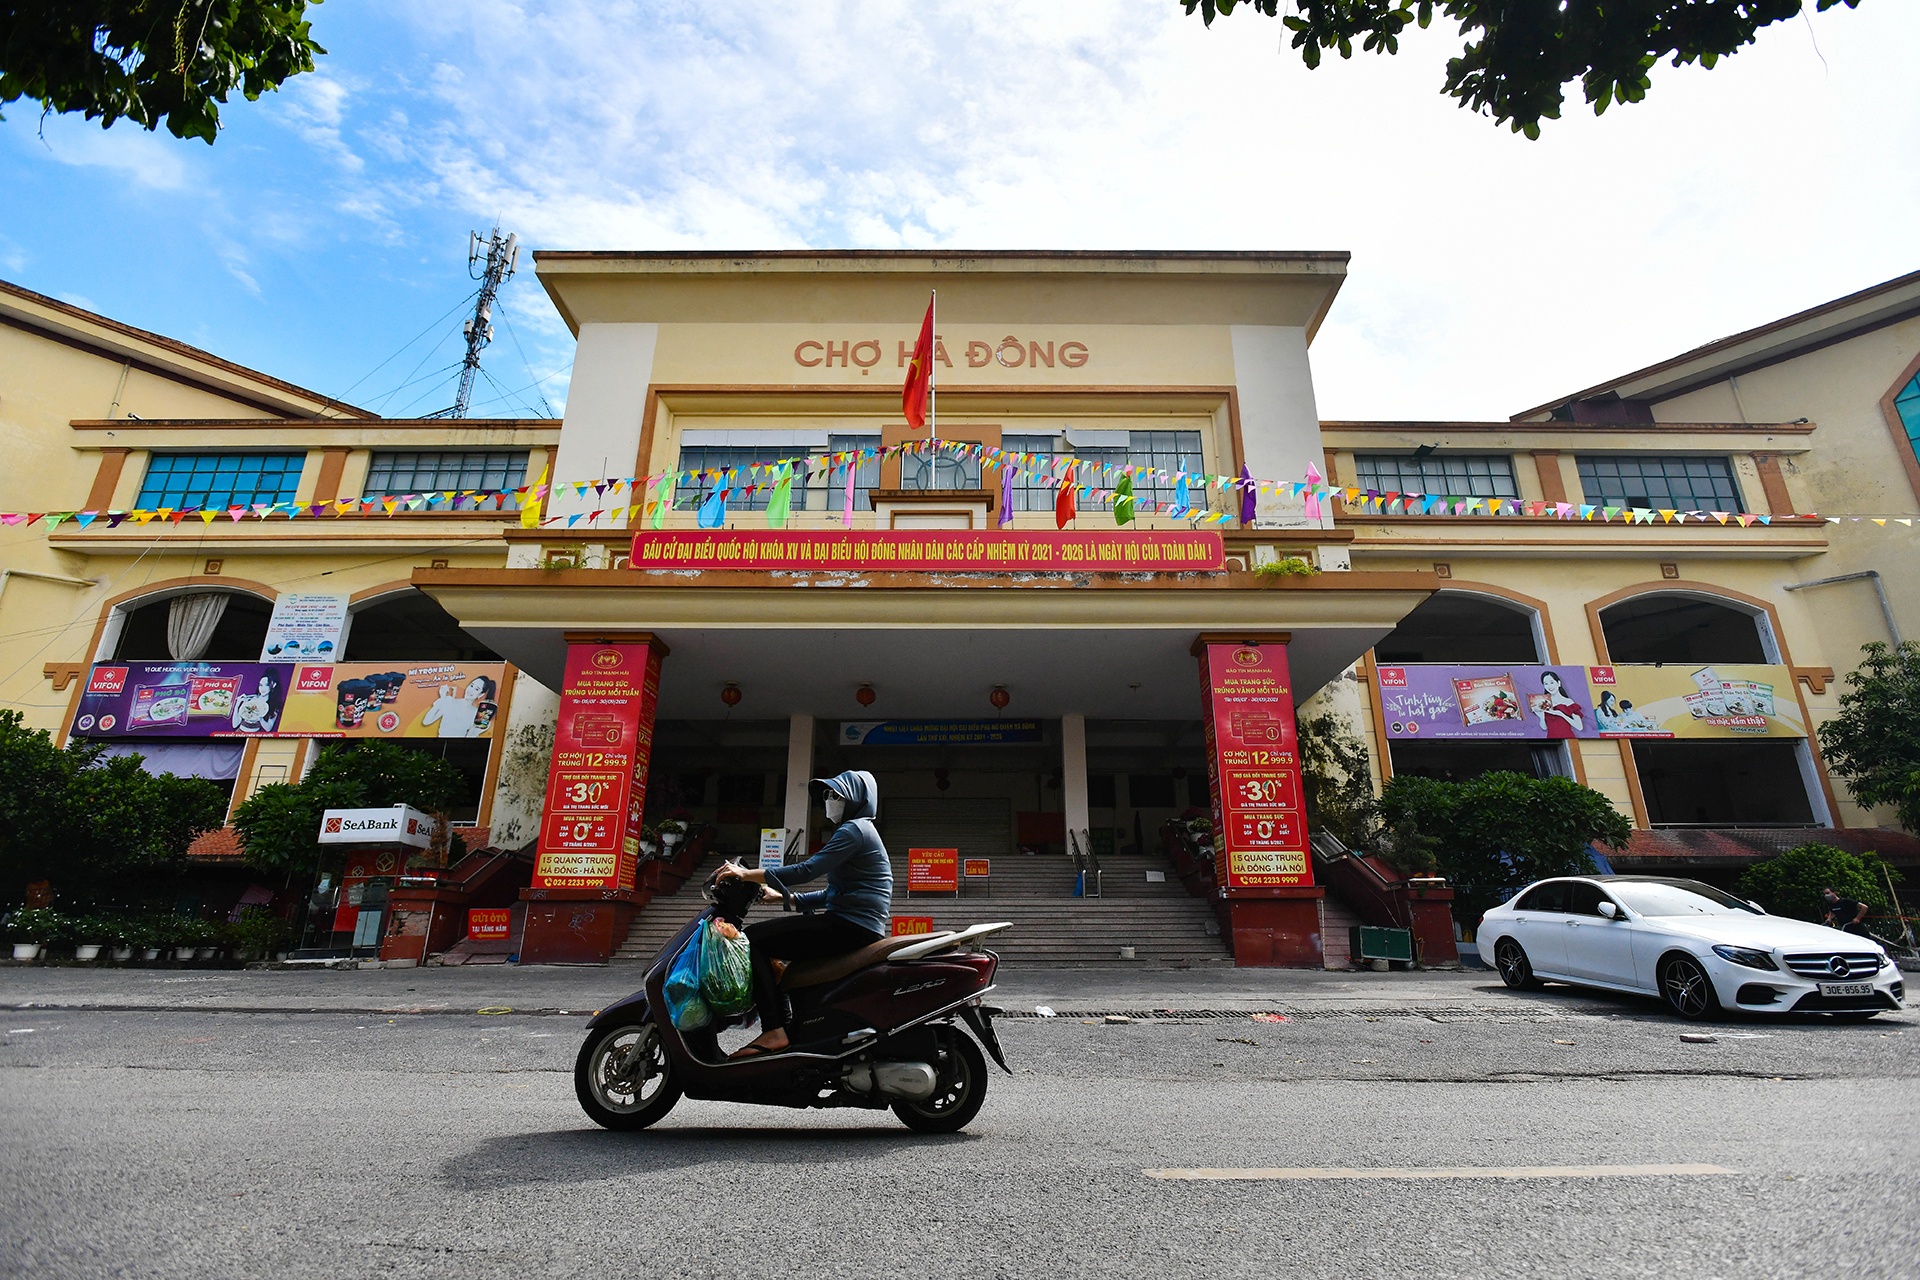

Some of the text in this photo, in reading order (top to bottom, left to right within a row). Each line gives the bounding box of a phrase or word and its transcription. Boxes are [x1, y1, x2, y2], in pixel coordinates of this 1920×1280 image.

[794, 340, 882, 376] CHỢ
[965, 335, 1089, 368] ĐÔNG
[643, 537, 661, 559] BẦU
[663, 536, 678, 559] CỬ
[677, 543, 694, 563] ĐẠI
[694, 536, 715, 559] BIỂU
[717, 537, 741, 560] QUỐC
[743, 539, 759, 563] HỘI
[760, 539, 783, 559] KHÓA
[786, 543, 798, 559] XV
[800, 539, 812, 559] VÀ
[814, 543, 829, 564] ĐẠI
[831, 536, 852, 560] BIỂU
[854, 539, 869, 564] HỘI
[871, 537, 896, 560] ĐỒNG
[898, 539, 923, 560] NHÂN
[926, 539, 944, 560] DÂN
[946, 539, 964, 560] CÁC
[966, 537, 984, 560] CẤP
[987, 540, 1016, 564] NHIỆM
[1018, 540, 1029, 560] KỲ
[1032, 543, 1052, 561] 2021
[1062, 543, 1083, 561] 2026
[1085, 540, 1097, 561] LÀ
[1098, 540, 1122, 561] NGÀY
[1124, 540, 1142, 565] HỘI
[1142, 536, 1160, 561] CỦA
[1162, 540, 1186, 561] TOÀN
[1187, 540, 1206, 561] DÂN
[93, 682, 122, 690] VIFON
[301, 679, 328, 689] VIFON
[154, 689, 173, 698] PHỞ
[565, 688, 586, 696] TRÚNG
[588, 688, 606, 696] VÀNG
[622, 687, 639, 696] TUẦN
[1214, 686, 1235, 694] TRÚNG
[1237, 686, 1255, 694] VÀNG
[1271, 685, 1288, 694] TUẦN
[569, 751, 582, 759] HỘI
[1252, 751, 1269, 765] 12
[586, 753, 604, 767] 12
[343, 819, 398, 830] SeABank
[597, 867, 612, 875] NỘI
[1289, 864, 1304, 873] NỘI
[472, 912, 507, 922] GỬI ÔTÔ
[897, 919, 927, 934] CẤM
[1826, 985, 1871, 994] 30E-856.95
